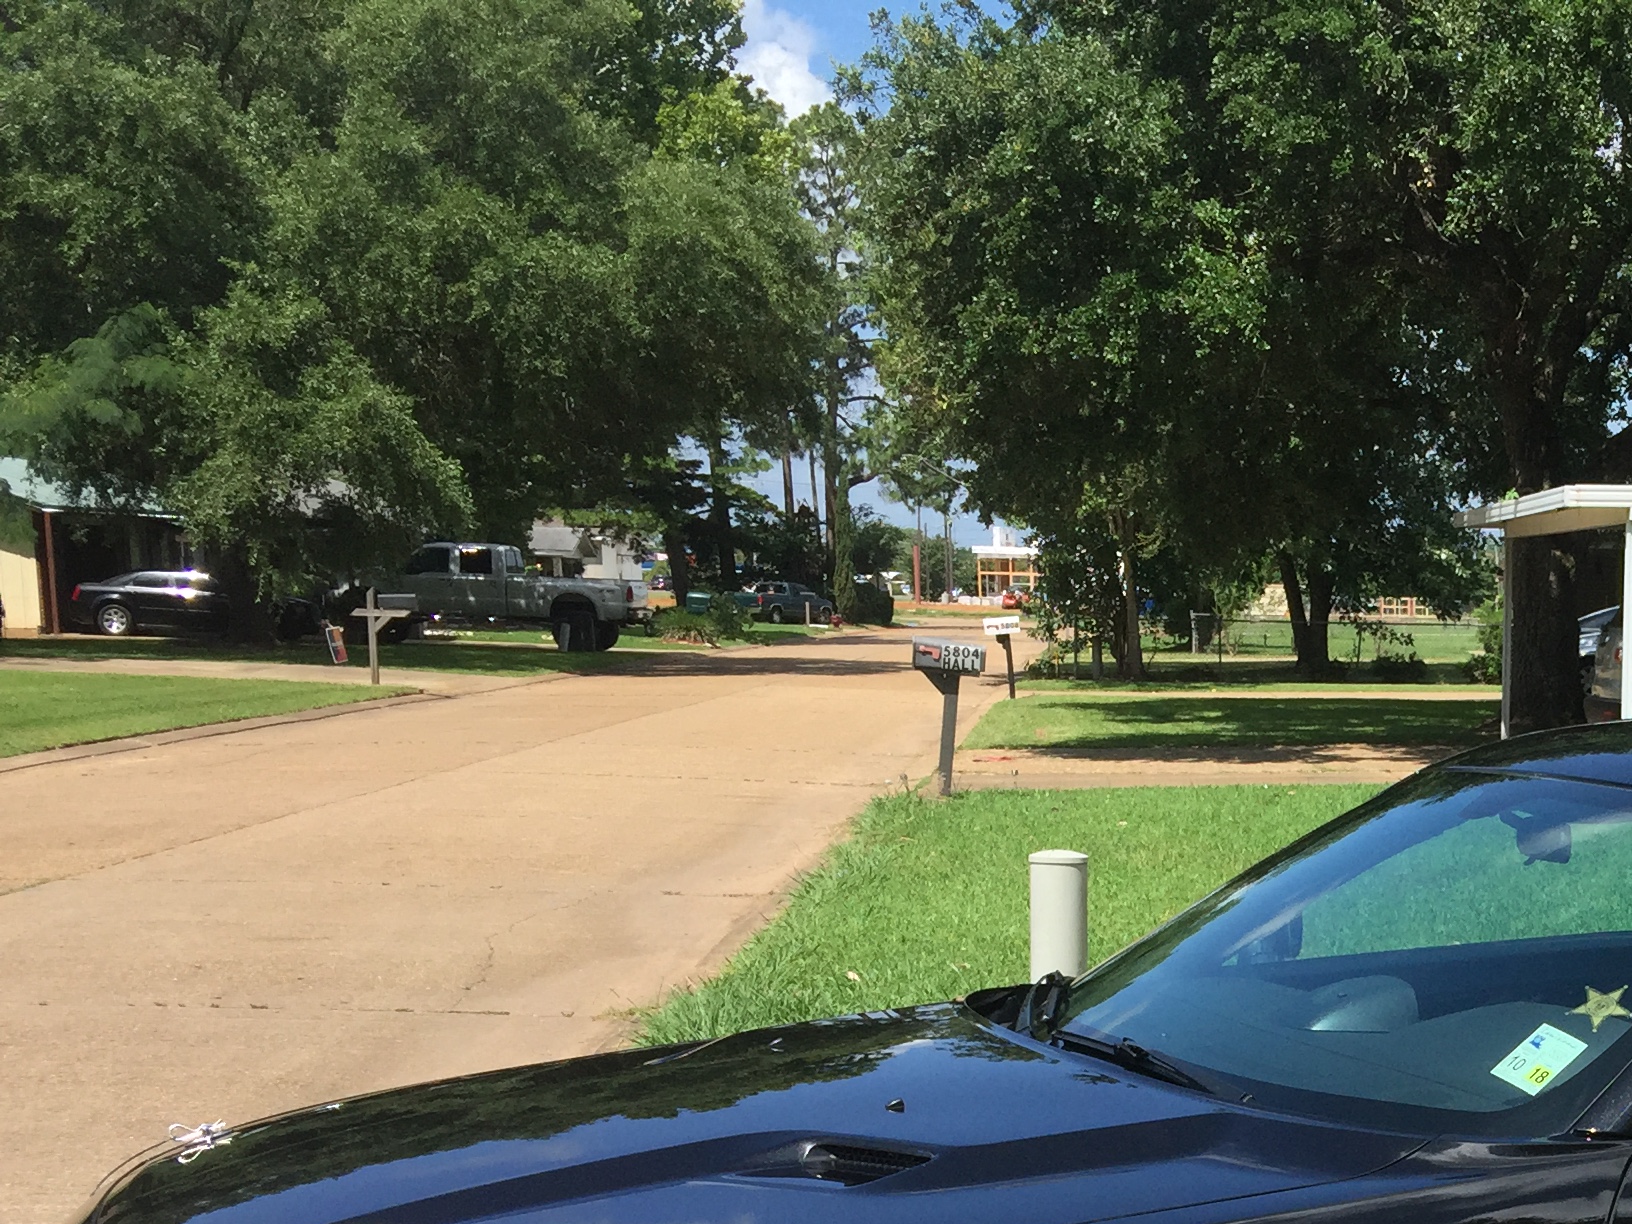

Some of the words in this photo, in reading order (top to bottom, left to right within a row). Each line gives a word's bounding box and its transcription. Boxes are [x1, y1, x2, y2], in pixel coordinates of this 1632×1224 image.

[943, 646, 980, 660] 5804
[942, 657, 979, 671] HALL
[1507, 1055, 1526, 1071] 10
[1529, 1068, 1550, 1084] 18
